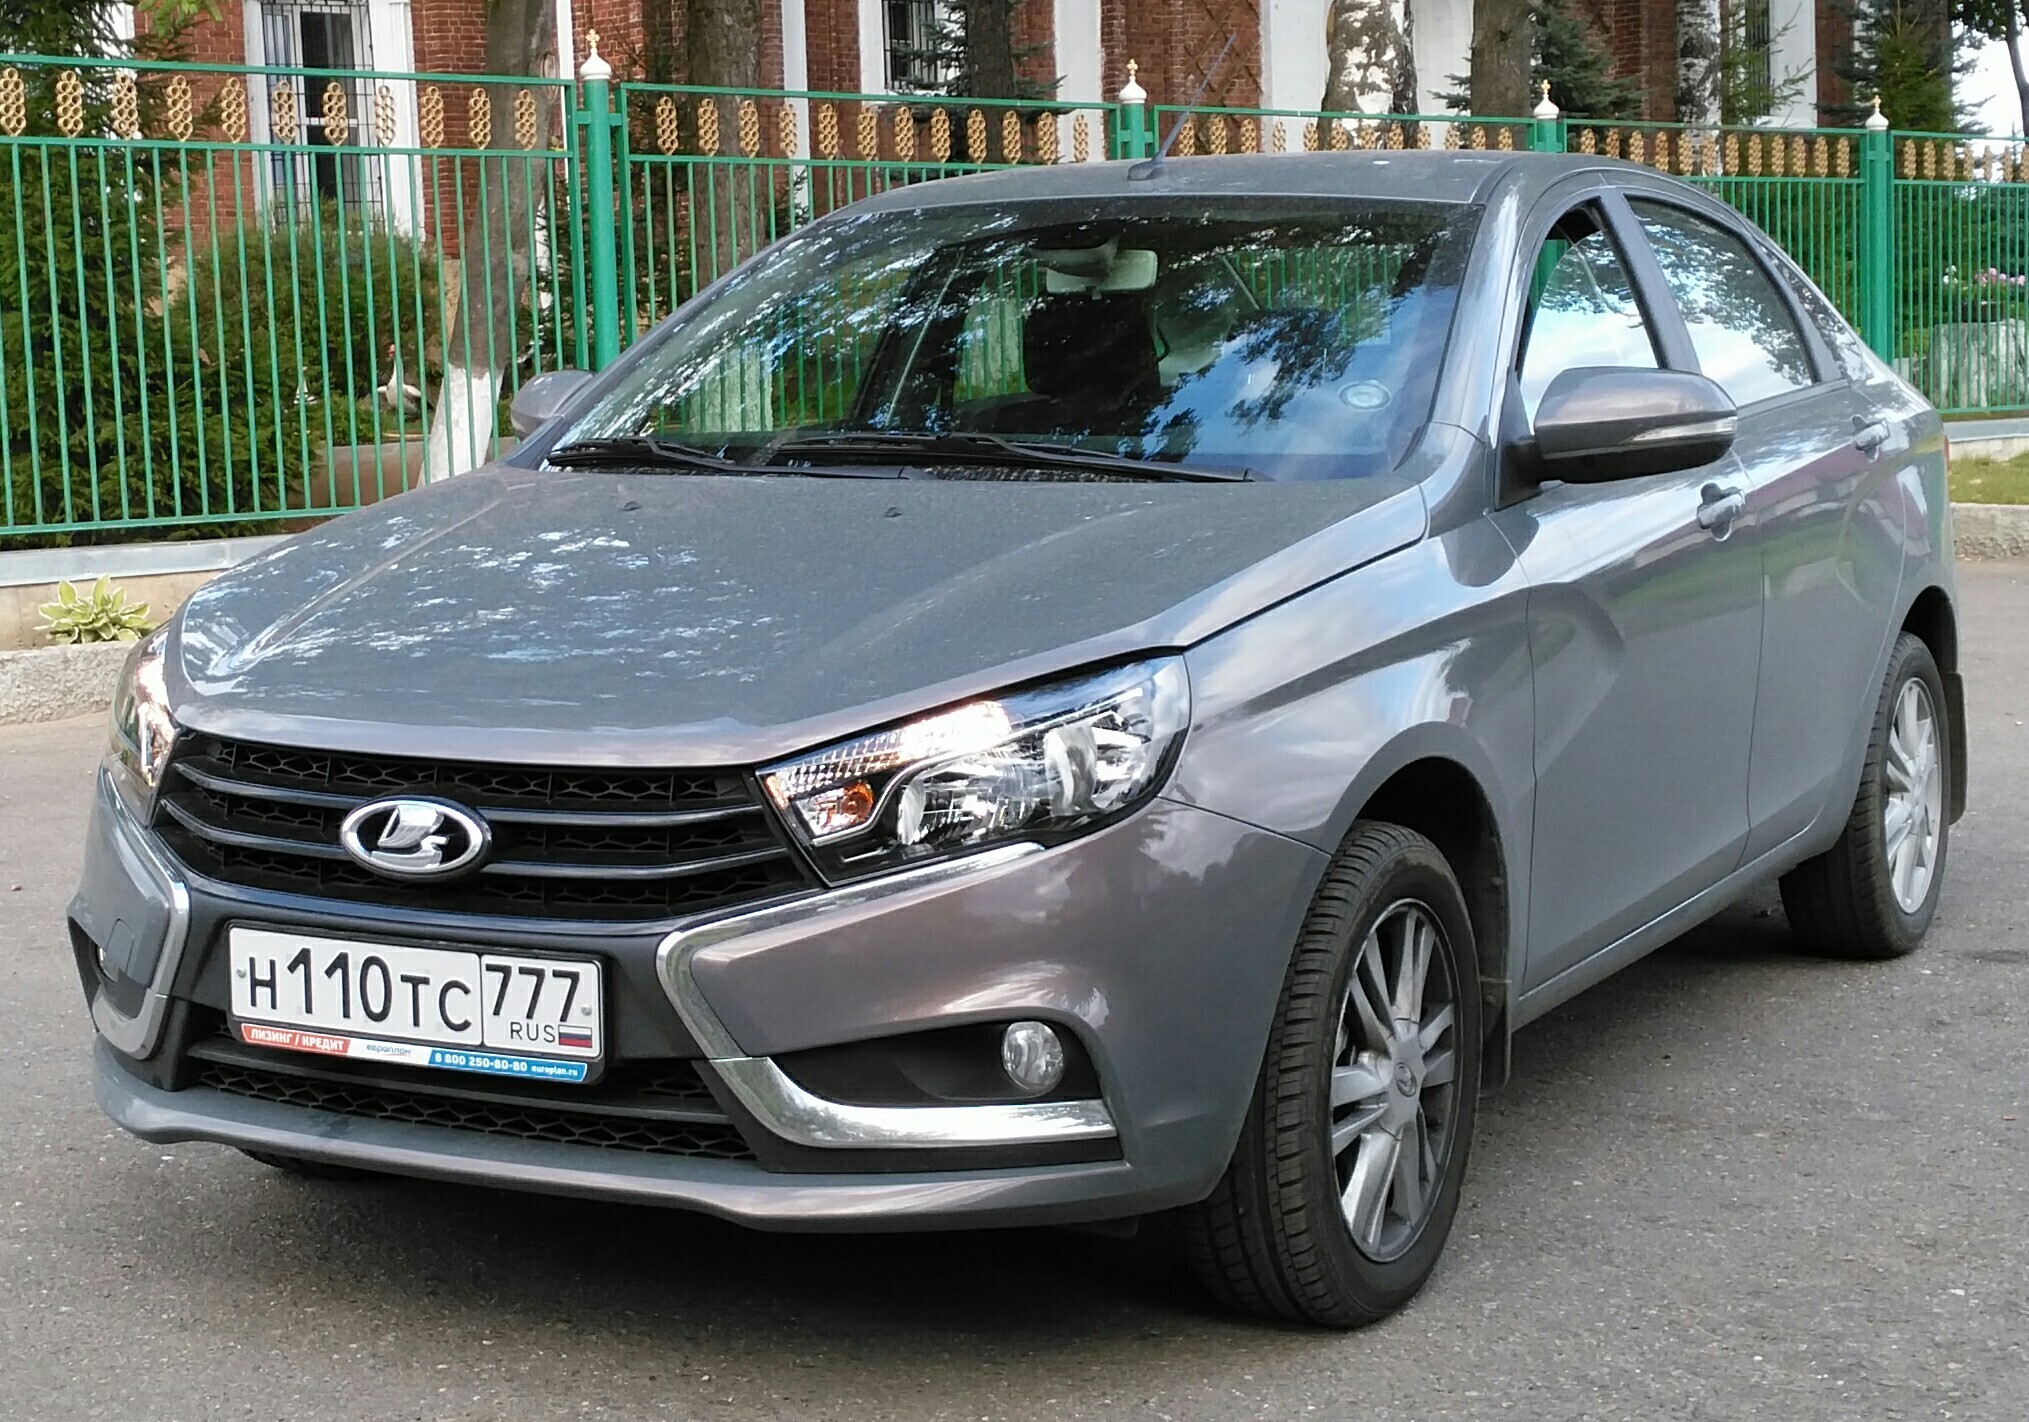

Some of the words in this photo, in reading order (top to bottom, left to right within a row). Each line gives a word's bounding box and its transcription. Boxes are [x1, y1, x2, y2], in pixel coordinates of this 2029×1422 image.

[248, 947, 473, 1032] Н110ТС
[485, 963, 581, 1022] 777
[251, 1028, 293, 1044] ЛИЗИНГ
[302, 1036, 345, 1051] КРЕДИТ
[510, 1021, 556, 1043] RUS
[444, 1054, 466, 1066] 800
[469, 1056, 528, 1072] 250-80-80
[531, 1065, 578, 1077] europlan.ru
